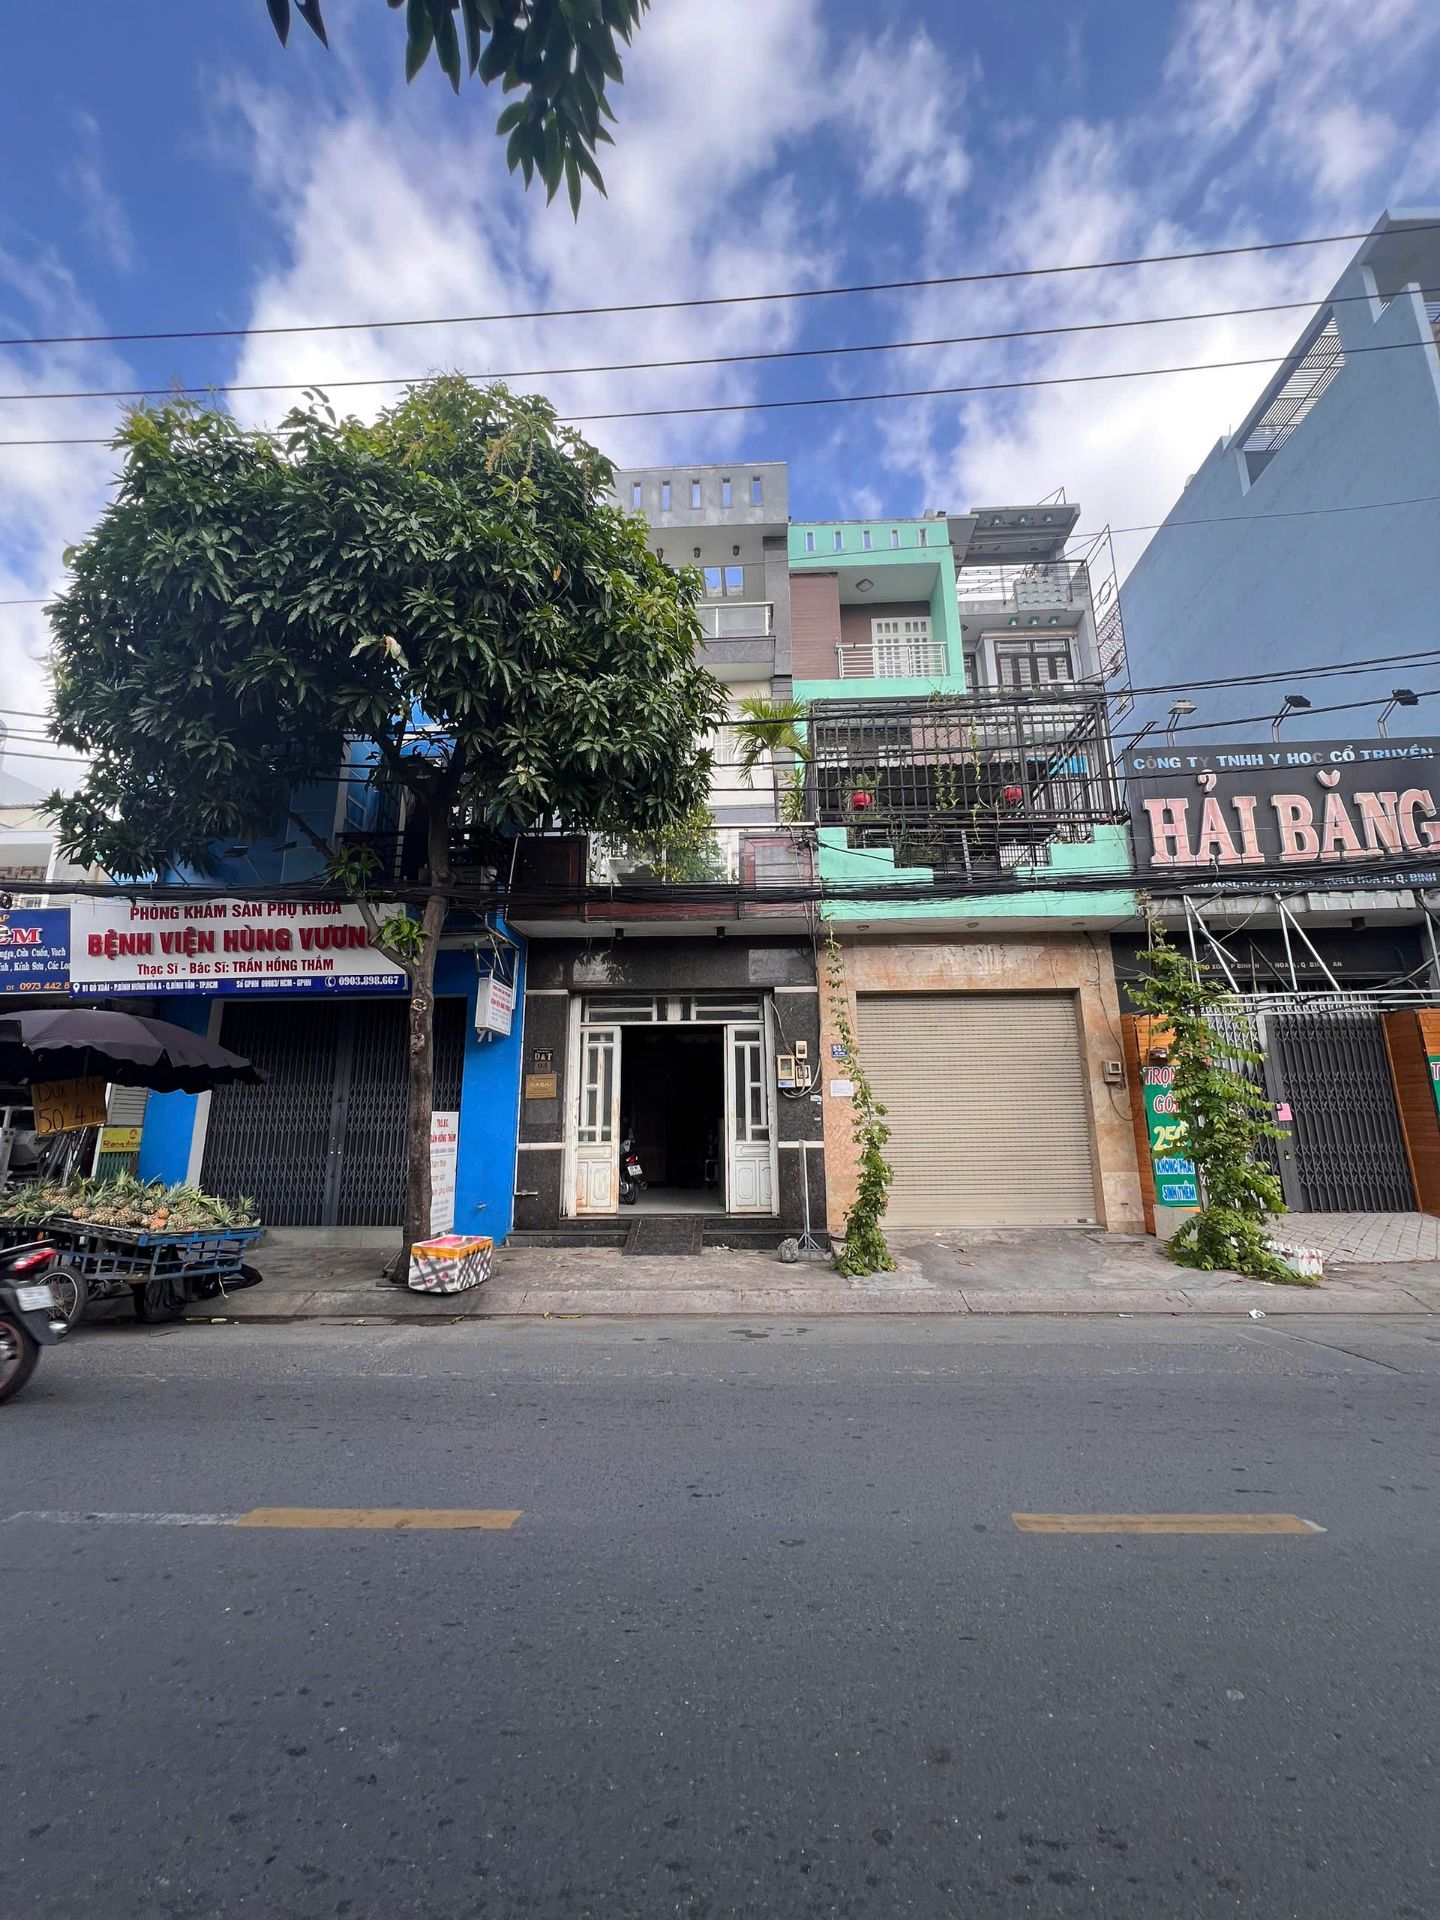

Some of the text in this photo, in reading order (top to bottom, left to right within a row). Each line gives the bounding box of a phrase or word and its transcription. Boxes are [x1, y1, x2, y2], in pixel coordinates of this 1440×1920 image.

[1133, 756, 1181, 770] CÔNG
[1186, 755, 1211, 768] TY
[1216, 752, 1264, 767] TNHH
[1269, 753, 1280, 765] Y
[1143, 769, 1440, 867] HẢI BĂNG
[130, 904, 179, 920] PHÒNG
[184, 902, 227, 919] KHÁM
[267, 902, 297, 918] PHỤ
[88, 924, 374, 960] BỆNH VIỆN HÙNG VƯƠN
[137, 964, 163, 977] Thạc
[167, 963, 178, 975] Sĩ
[190, 962, 210, 974] Bác
[339, 976, 399, 986] 0903.898.667
